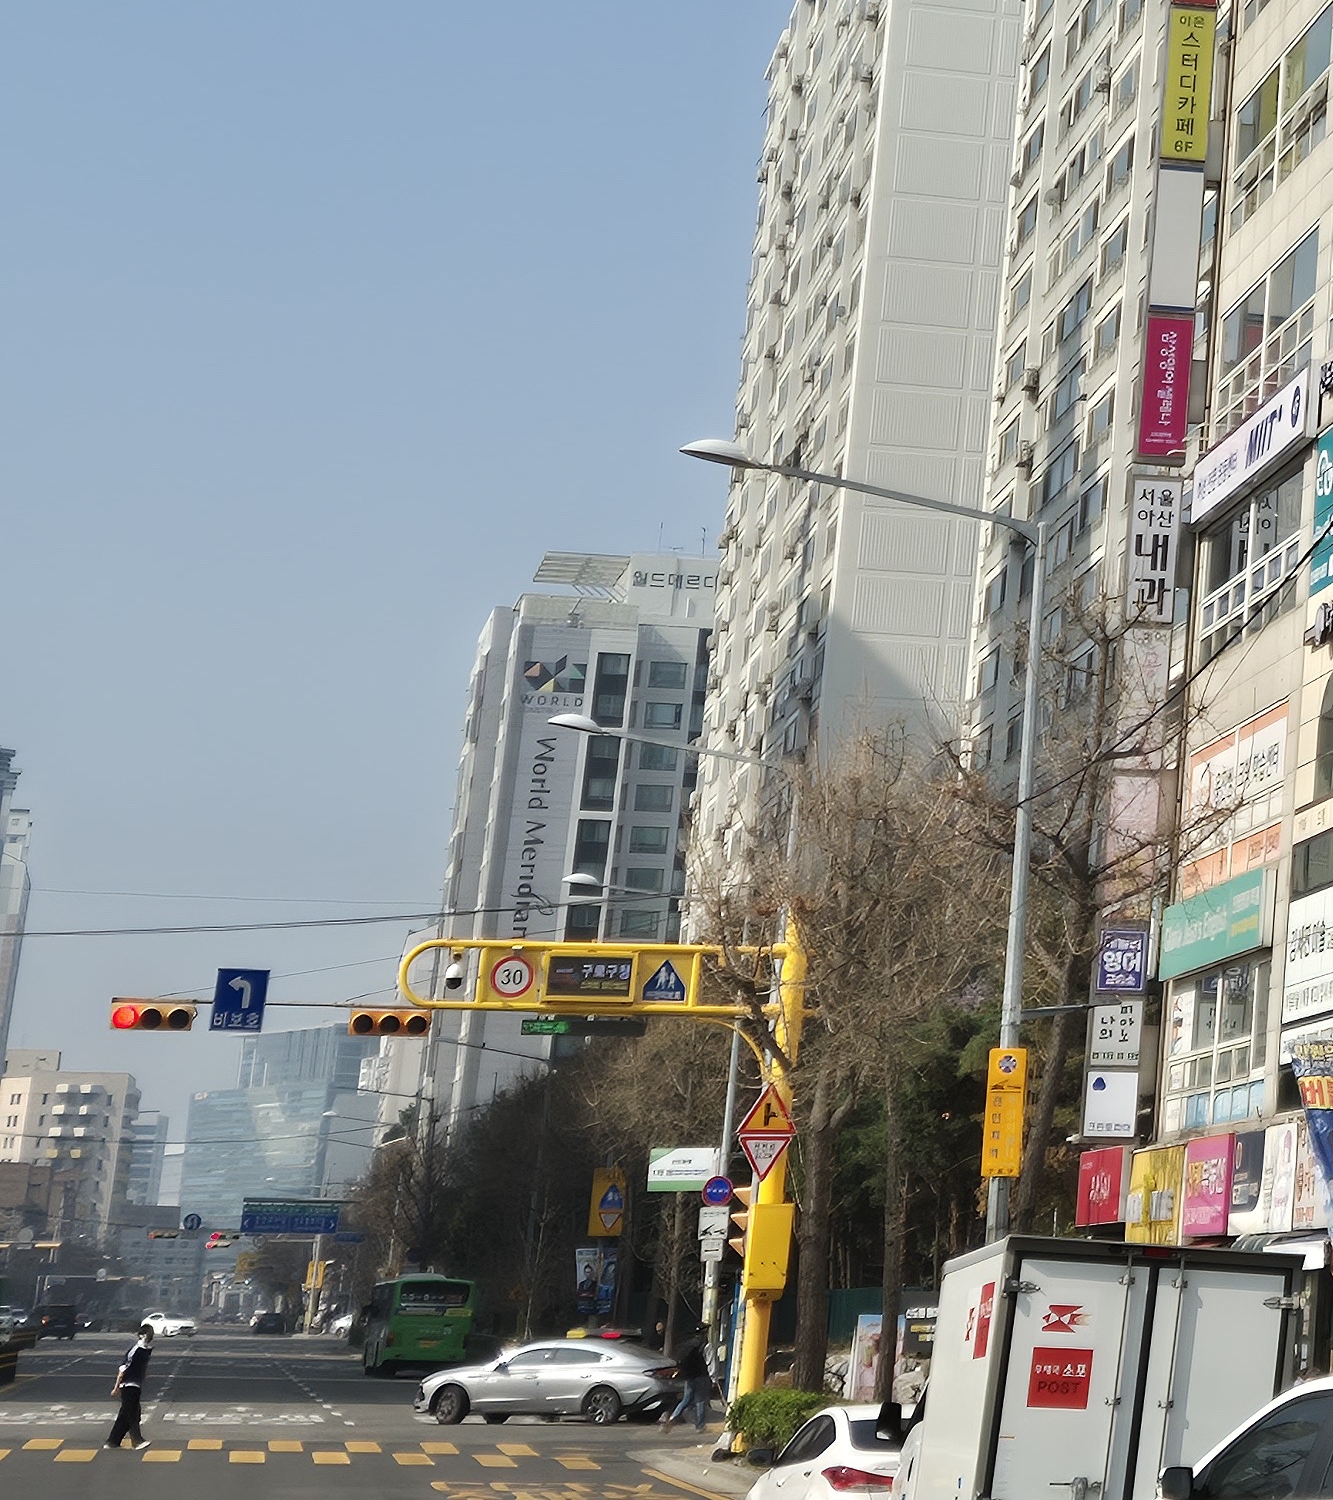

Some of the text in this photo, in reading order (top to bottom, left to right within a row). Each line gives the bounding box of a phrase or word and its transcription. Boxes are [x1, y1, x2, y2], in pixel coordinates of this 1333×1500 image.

[1176, 31, 1200, 137] 스터디카페
[1139, 488, 1174, 507] 서울
[1137, 510, 1174, 528] 아산
[1133, 534, 1171, 615] 내과
[520, 694, 583, 707] WORLD
[528, 738, 557, 809] World
[501, 968, 523, 986] 30
[213, 1011, 260, 1029] 비보호
[1037, 1381, 1081, 1394] POST
